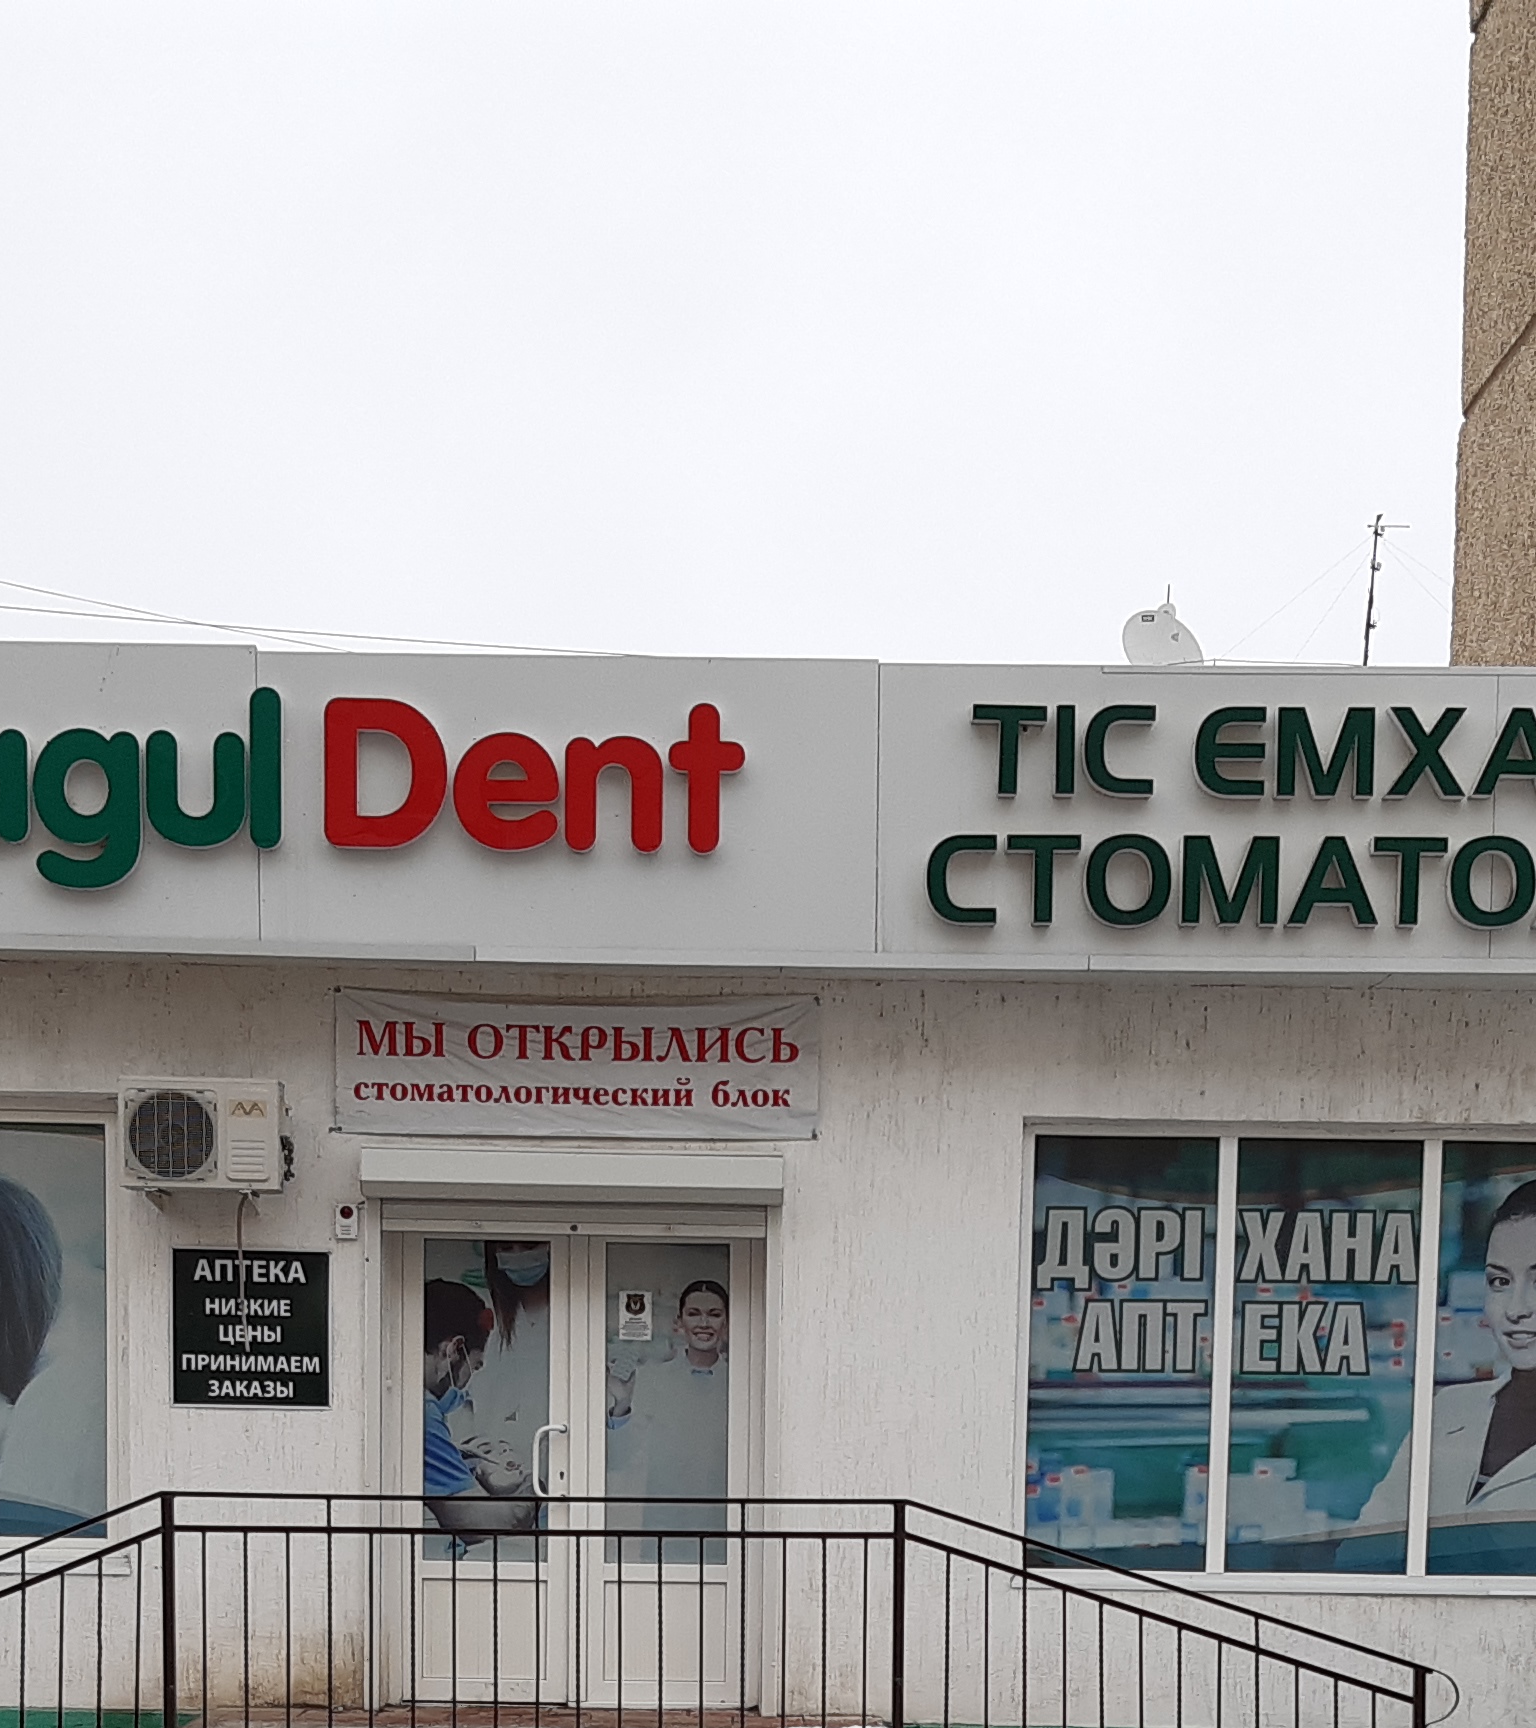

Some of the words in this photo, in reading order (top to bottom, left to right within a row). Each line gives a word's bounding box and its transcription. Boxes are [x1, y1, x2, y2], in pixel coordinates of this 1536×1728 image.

[971, 703, 1156, 799] ТІС
[322, 697, 745, 855] Dent
[356, 1019, 446, 1058] МЫ
[467, 1023, 800, 1064] ОТКРЫЛИСЬ
[353, 1077, 694, 1107] стоматологический
[711, 1079, 791, 1108] блок
[193, 1258, 307, 1284] АПТЕКА
[204, 1297, 292, 1317] НИЗКИЕ
[218, 1324, 282, 1345] ЦЕНЫ
[181, 1353, 321, 1374] ПРИНИМАЕМ
[207, 1380, 294, 1398] ЗАКАЗЫ
